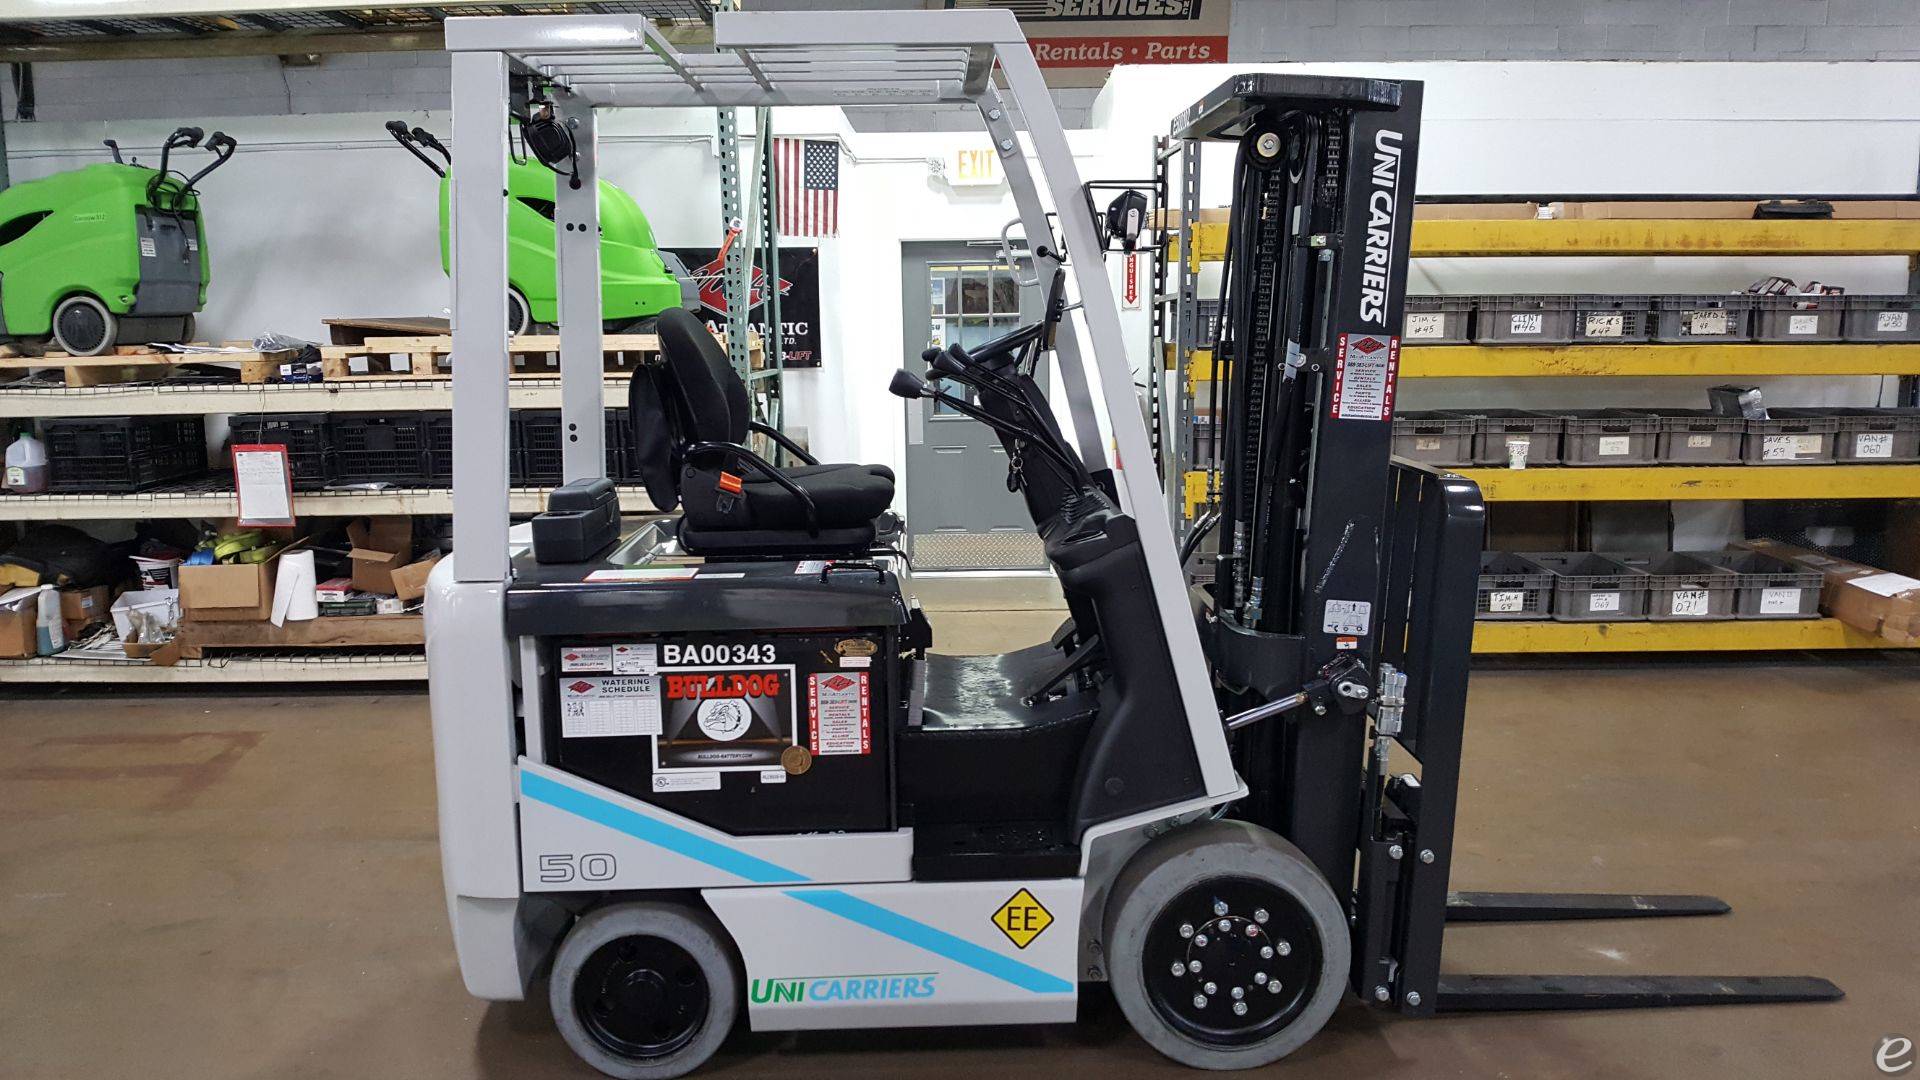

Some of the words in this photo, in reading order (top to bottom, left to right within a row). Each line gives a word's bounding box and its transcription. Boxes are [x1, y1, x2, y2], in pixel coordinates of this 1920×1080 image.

[1034, 41, 1124, 61] Rentals
[1145, 42, 1211, 60] Parts
[958, 149, 994, 177] EXIT
[704, 319, 809, 335] ATANTIC
[1511, 314, 1539, 322] CLINT
[1332, 337, 1346, 413] SERVICE
[1383, 339, 1397, 416] RENTALS
[1863, 444, 1881, 453] 060
[663, 644, 776, 664] BA00343
[601, 678, 650, 687] WATERING
[602, 686, 651, 694] SCHEDULE
[666, 673, 780, 699] BULLDOG
[809, 676, 818, 750] SERVICE
[861, 675, 869, 750] RENTALS
[540, 853, 617, 882] 50
[1008, 906, 1038, 931] EE
